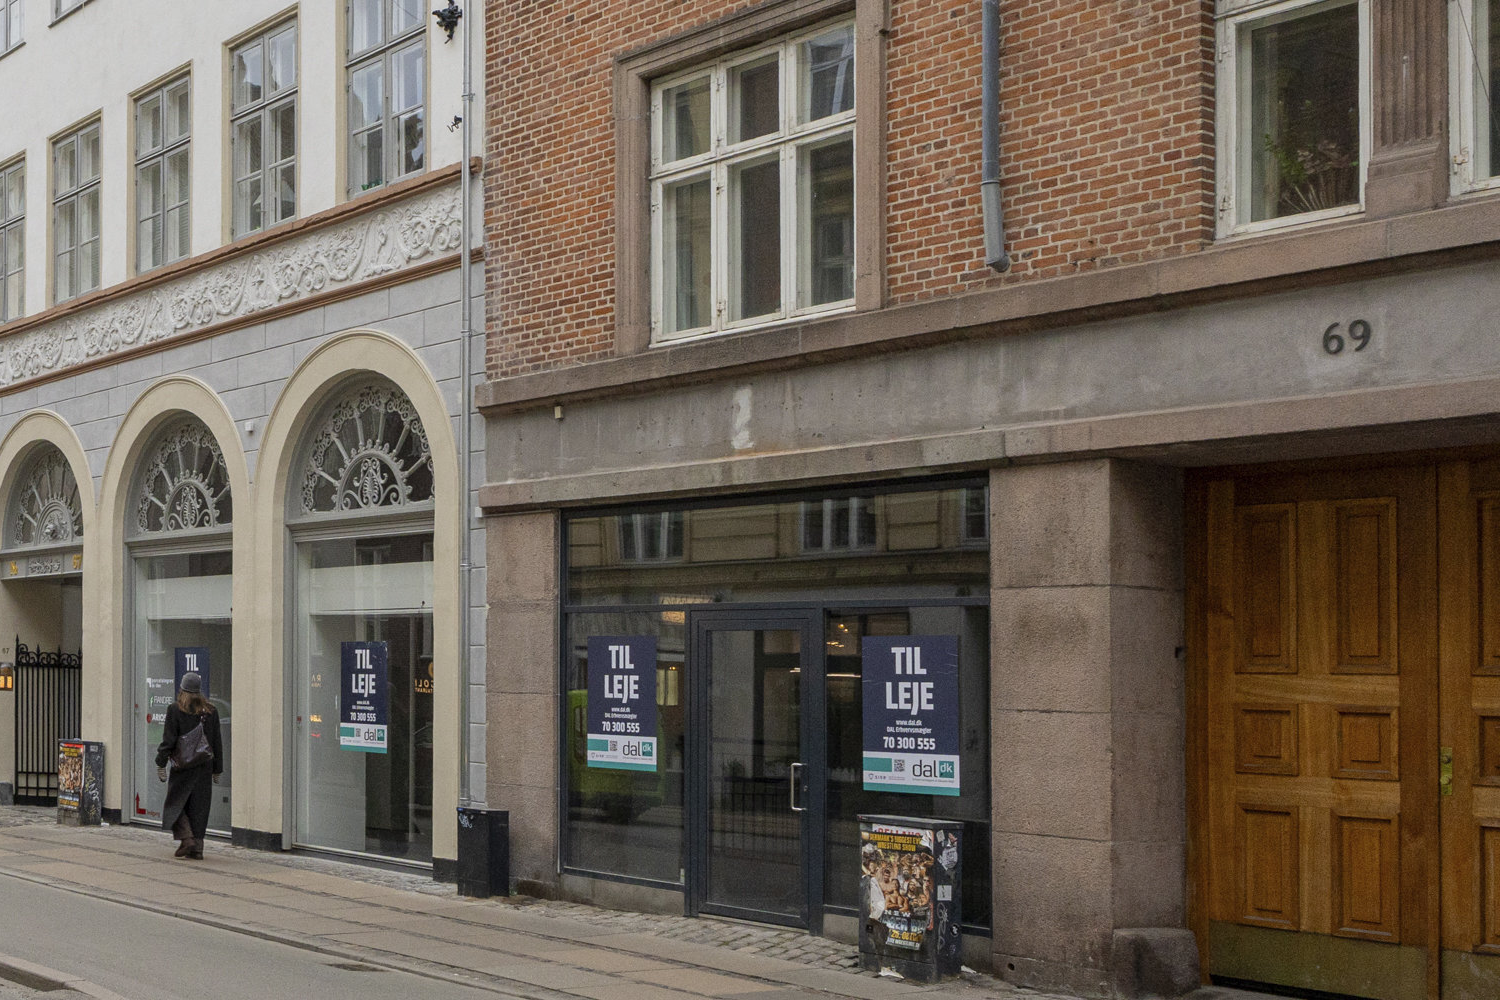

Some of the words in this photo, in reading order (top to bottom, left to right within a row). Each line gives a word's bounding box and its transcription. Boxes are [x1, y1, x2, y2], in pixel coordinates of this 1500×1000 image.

[1323, 319, 1371, 355] 69
[184, 653, 199, 672] TIL
[355, 649, 373, 669] TIL
[608, 645, 635, 670] TIL
[891, 646, 927, 675] TIL
[352, 673, 376, 698] LEJE
[603, 674, 640, 704] LEJE
[885, 681, 935, 716] LEJE
[350, 712, 357, 721] 70
[357, 712, 366, 722] 300
[367, 713, 377, 722] 555
[363, 728, 377, 742] dal
[602, 721, 611, 732] 70
[611, 721, 626, 733] 300
[626, 722, 640, 733] 555
[622, 740, 642, 757] dal
[642, 743, 652, 752] dk
[882, 736, 895, 749] 70
[896, 736, 915, 750] 300
[917, 737, 936, 750] 555
[912, 759, 938, 778] dal
[939, 762, 953, 773] dk
[902, 843, 916, 852] SHOW
